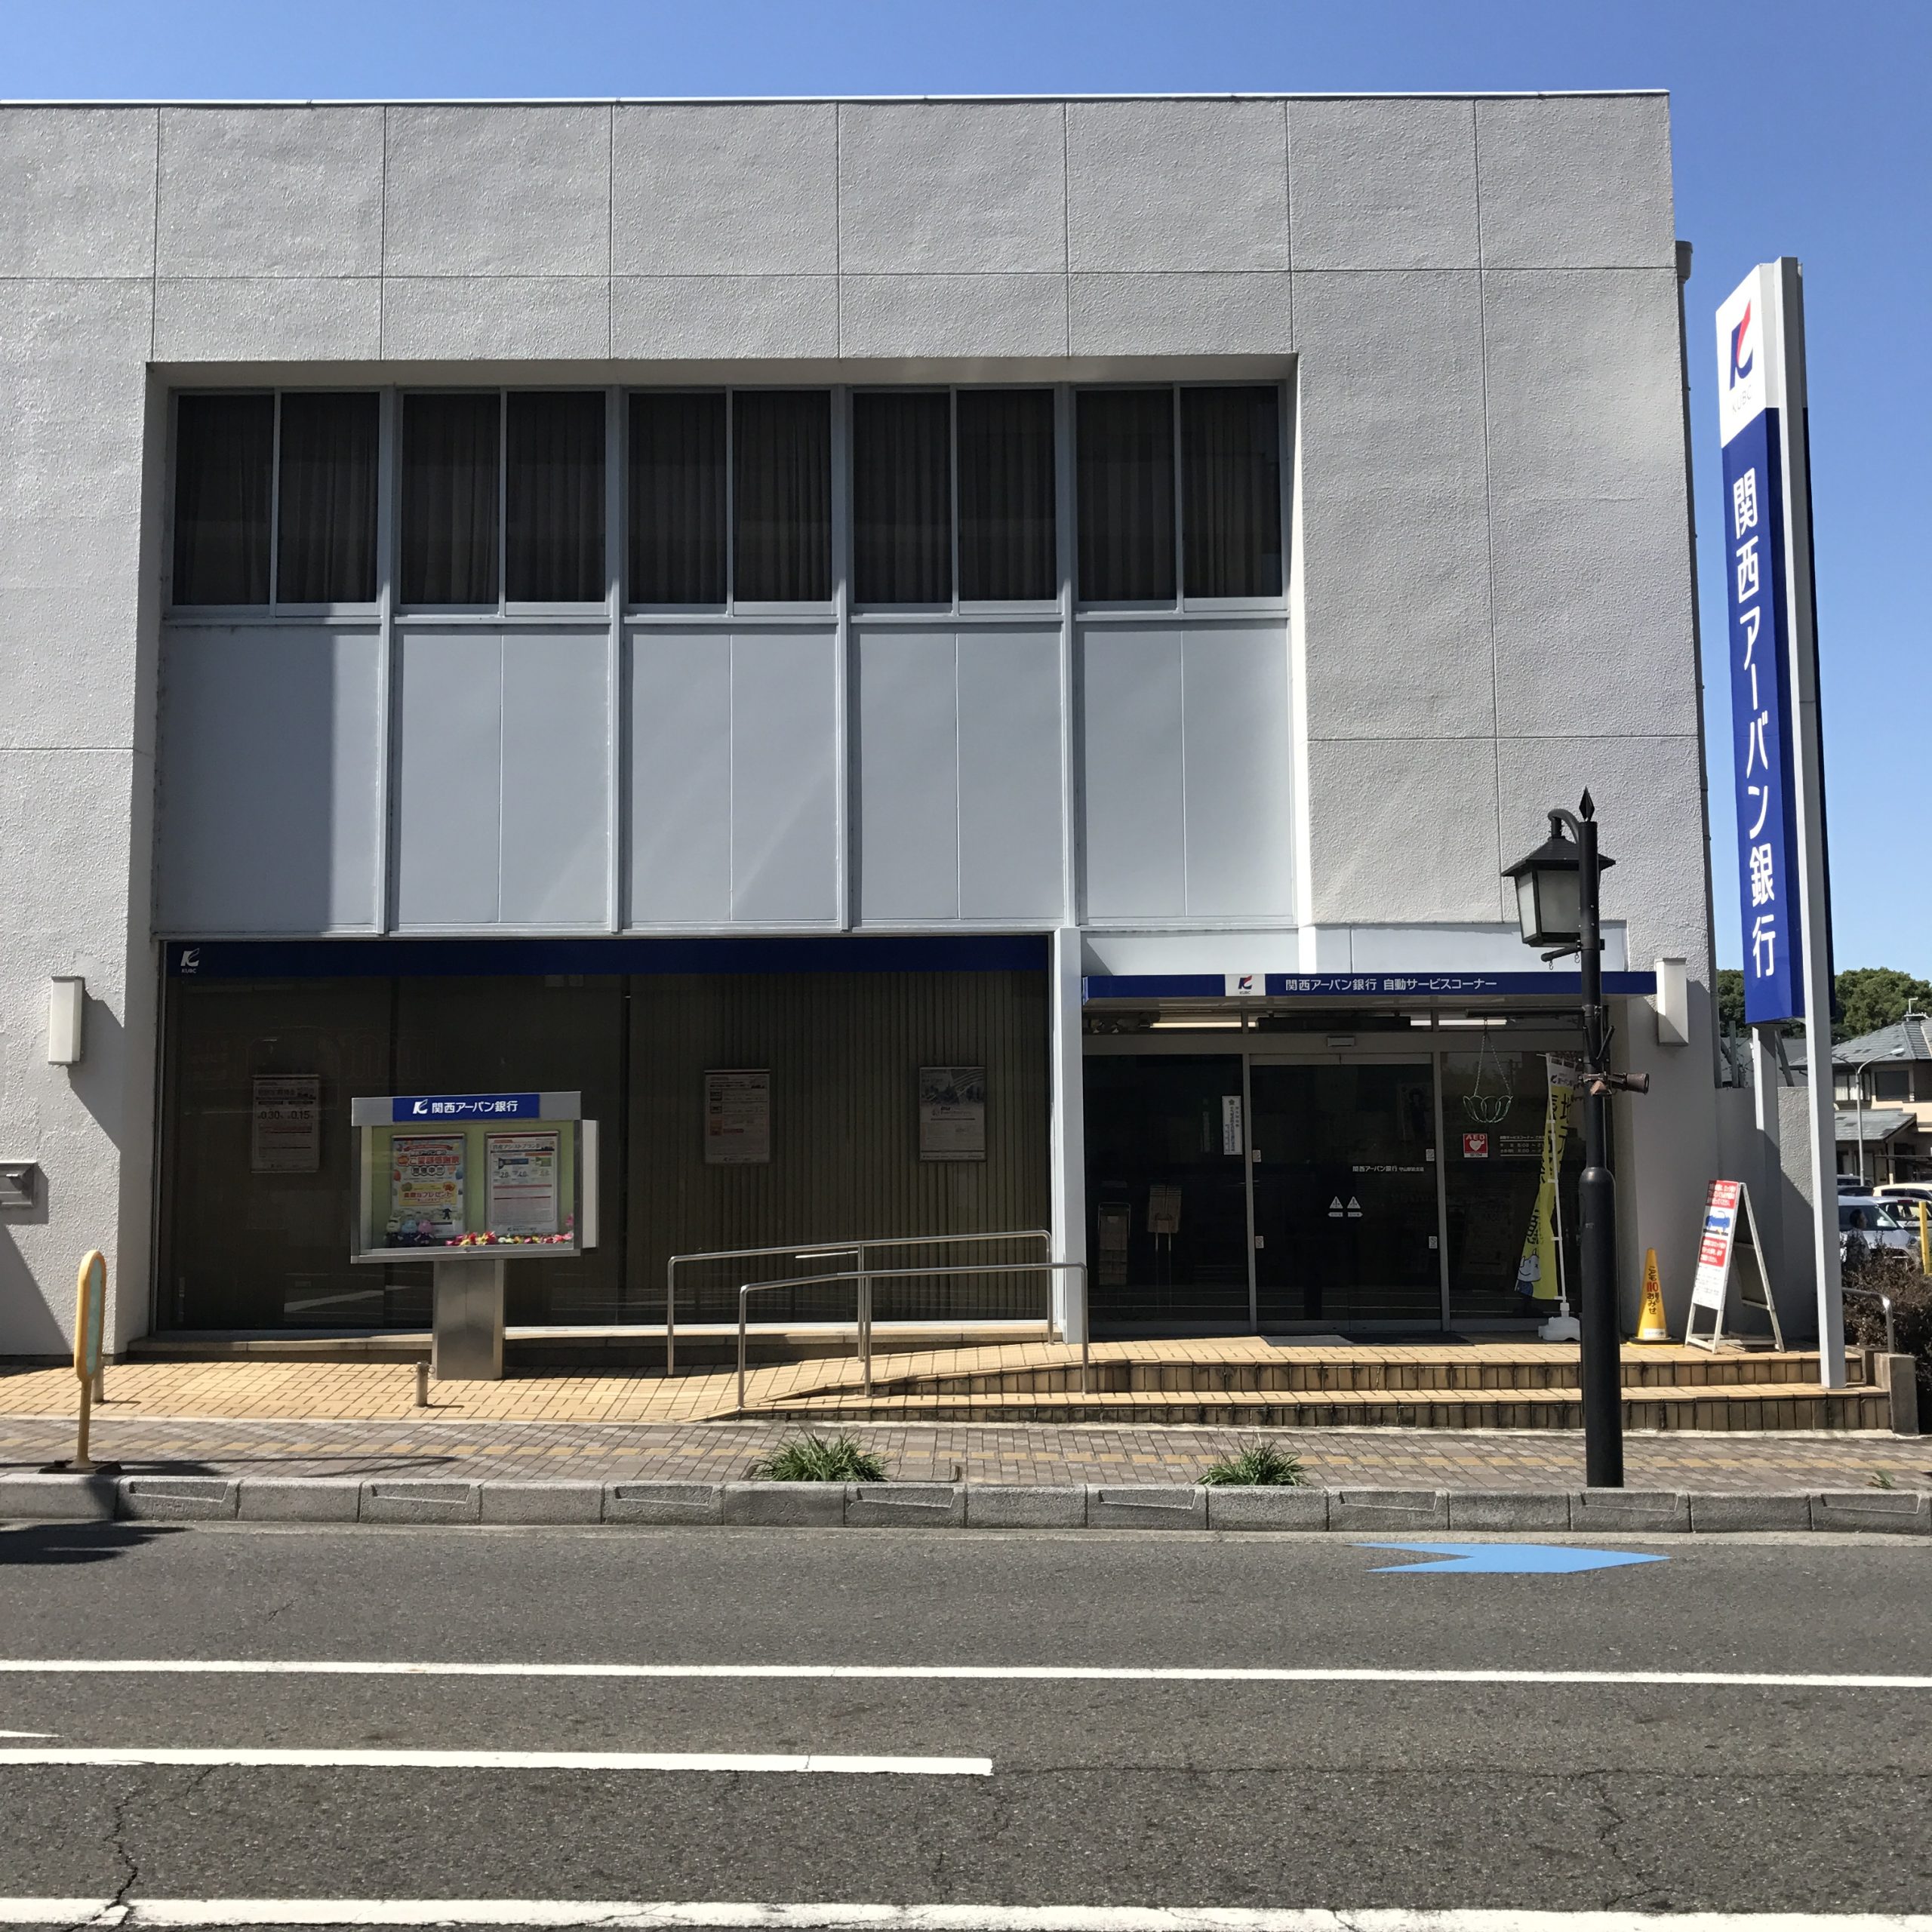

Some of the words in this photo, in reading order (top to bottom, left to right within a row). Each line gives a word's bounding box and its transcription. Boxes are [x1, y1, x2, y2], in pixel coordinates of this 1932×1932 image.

[1734, 466, 1776, 979] 関西アーバン銀行
[1285, 979, 1377, 991] 関西アーバン銀行
[1383, 979, 1497, 990] 自動サービスコーナー
[431, 1100, 518, 1114] 関西アーバン銀行
[1647, 1281, 1659, 1292] 110
[1647, 1293, 1657, 1315] おみせ
